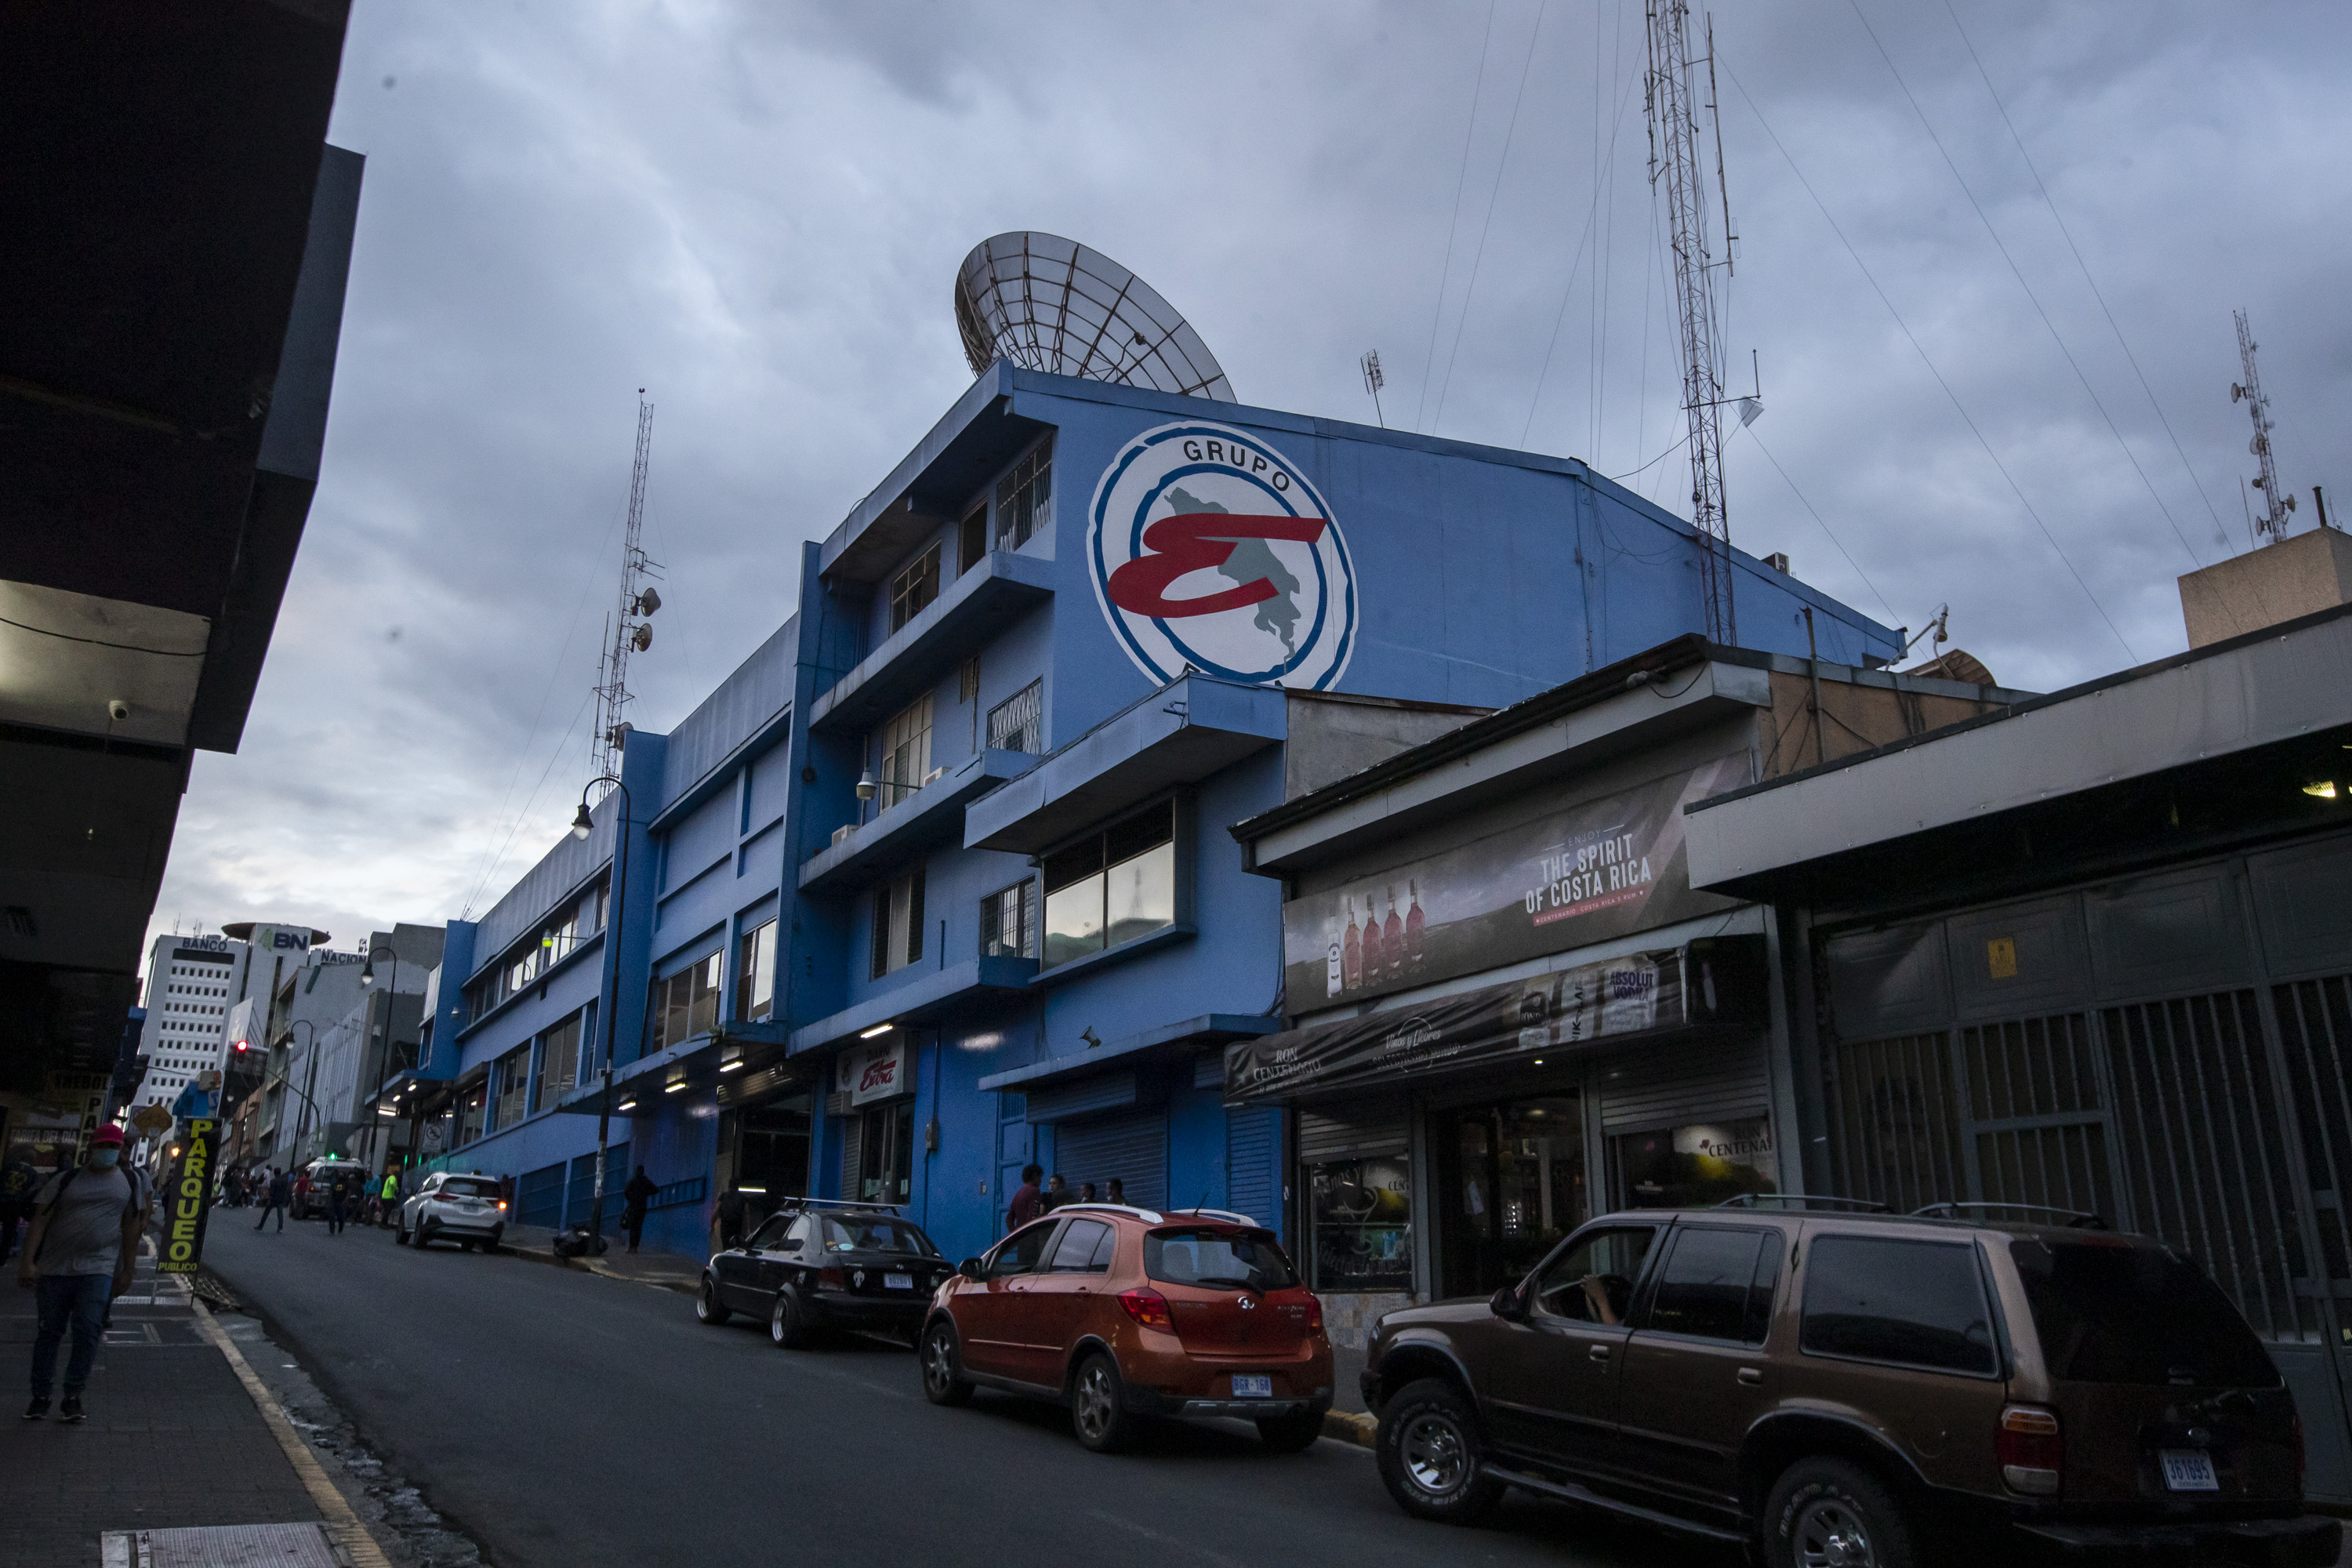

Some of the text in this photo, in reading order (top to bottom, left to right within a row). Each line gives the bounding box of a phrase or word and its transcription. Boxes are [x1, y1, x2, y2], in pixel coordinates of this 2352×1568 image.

[1184, 440, 1290, 492] GRUPO
[1567, 829, 1602, 847] ENJOY
[1541, 833, 1632, 883] THE SPIRIT
[1526, 856, 1651, 913] OF COSTA RICA
[1541, 908, 1577, 924] CENTENARIO
[1580, 903, 1600, 913] COSTA
[1623, 891, 1637, 901] RUM
[183, 937, 227, 951] BANCO
[274, 933, 308, 951] BN
[1610, 971, 1653, 987] ABSOLUT
[1613, 986, 1650, 1002] VODKA
[1385, 1029, 1442, 1051] Vinos y Licores
[1276, 1047, 1298, 1063] RON
[860, 1058, 897, 1092] Extra
[1254, 1059, 1322, 1081] CENTENARIO
[43, 1129, 59, 1143] DEL
[169, 1120, 213, 1261] PARQUEO
[158, 1261, 198, 1272] PUBLICO
[2166, 1458, 2210, 1481] 361695
